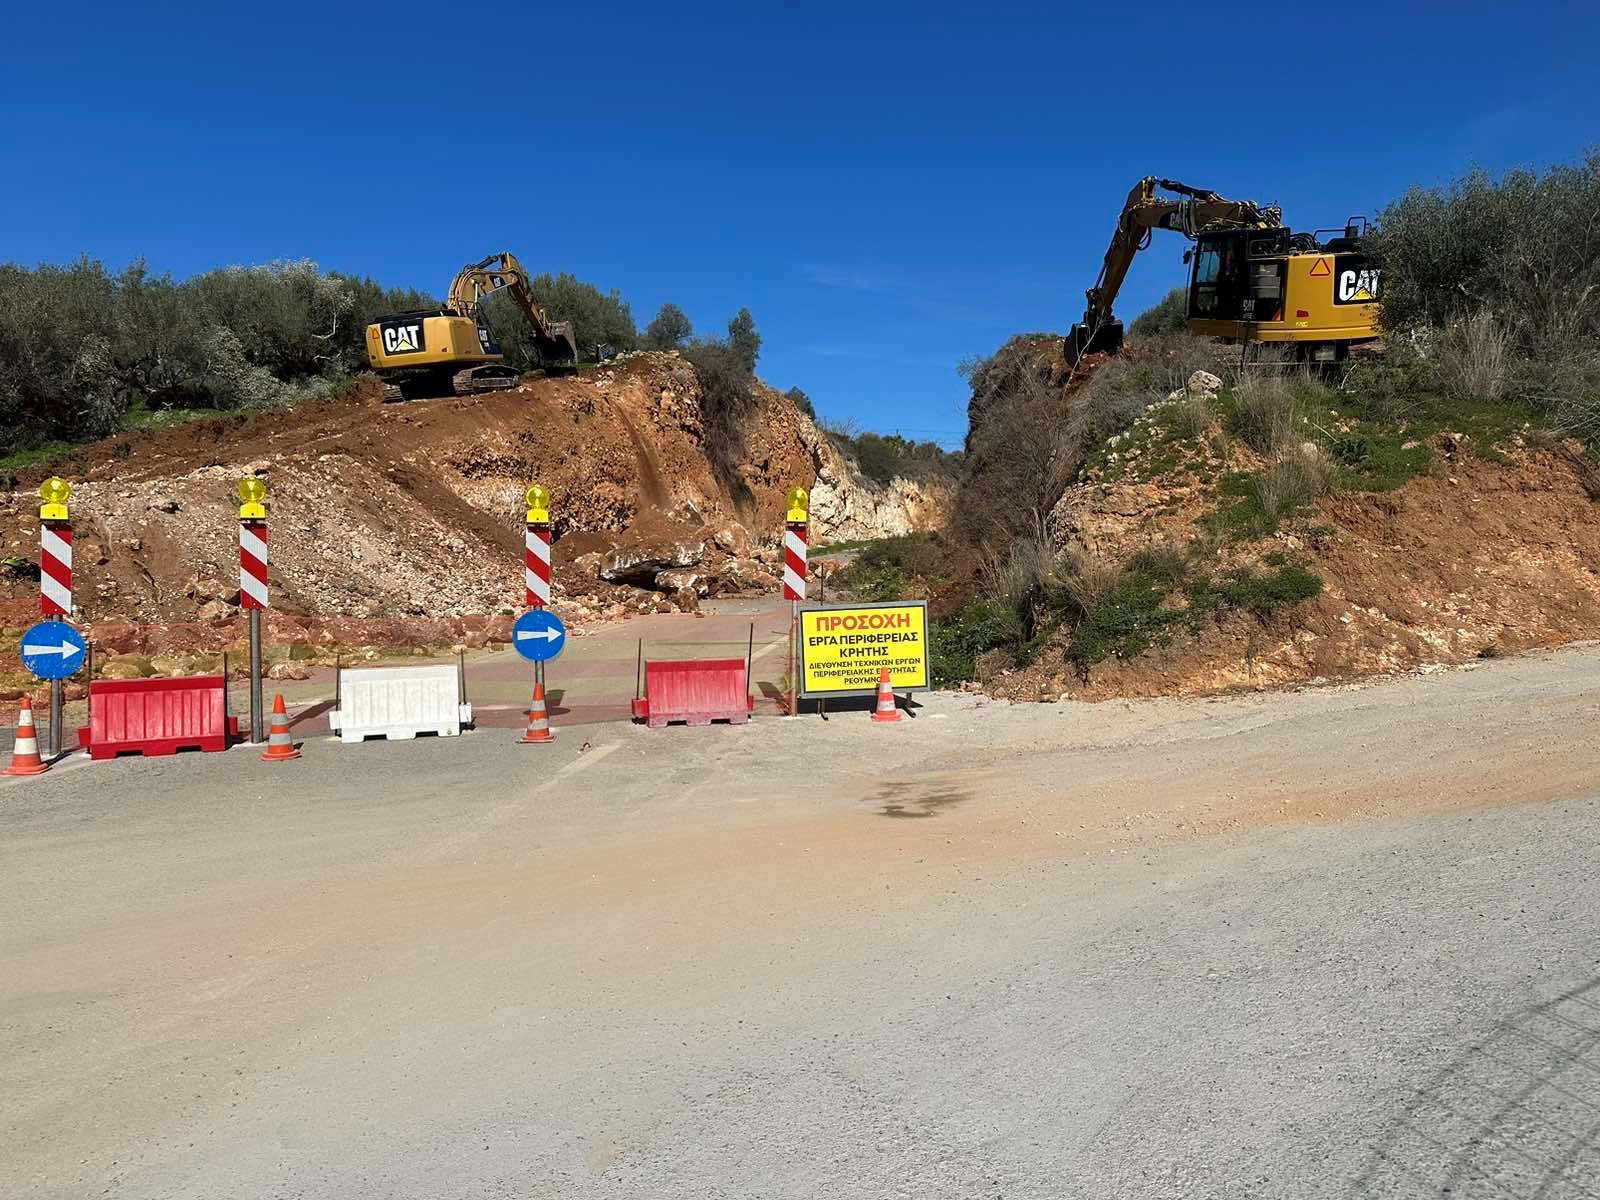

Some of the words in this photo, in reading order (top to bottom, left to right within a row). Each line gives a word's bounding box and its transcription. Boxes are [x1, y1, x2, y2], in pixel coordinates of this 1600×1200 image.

[1339, 269, 1382, 302] CAT
[384, 325, 419, 352] CAT
[816, 613, 911, 632] ΠΡΟΣΟΧΗ
[809, 636, 838, 646] ΕΡΓΑ
[839, 632, 918, 645] ΠΕΡΙΦΕΡΕΙΑΣ
[839, 646, 889, 658] ΚΡΗΤΗΣ
[809, 661, 853, 669] ΔΙΕΥΘΥΝΣΗ
[854, 659, 894, 667] ΤΕΧΝΙΚΩΝ
[895, 657, 921, 665] ΕΡΓΩΝ
[813, 668, 875, 678] ΠΕΡΙΦΕΡΕΙΑΚΗΣ
[876, 666, 917, 675] ΕΟΤΗΤΑΣ
[844, 676, 881, 685] ΡΕΘΥΜΝΟ
